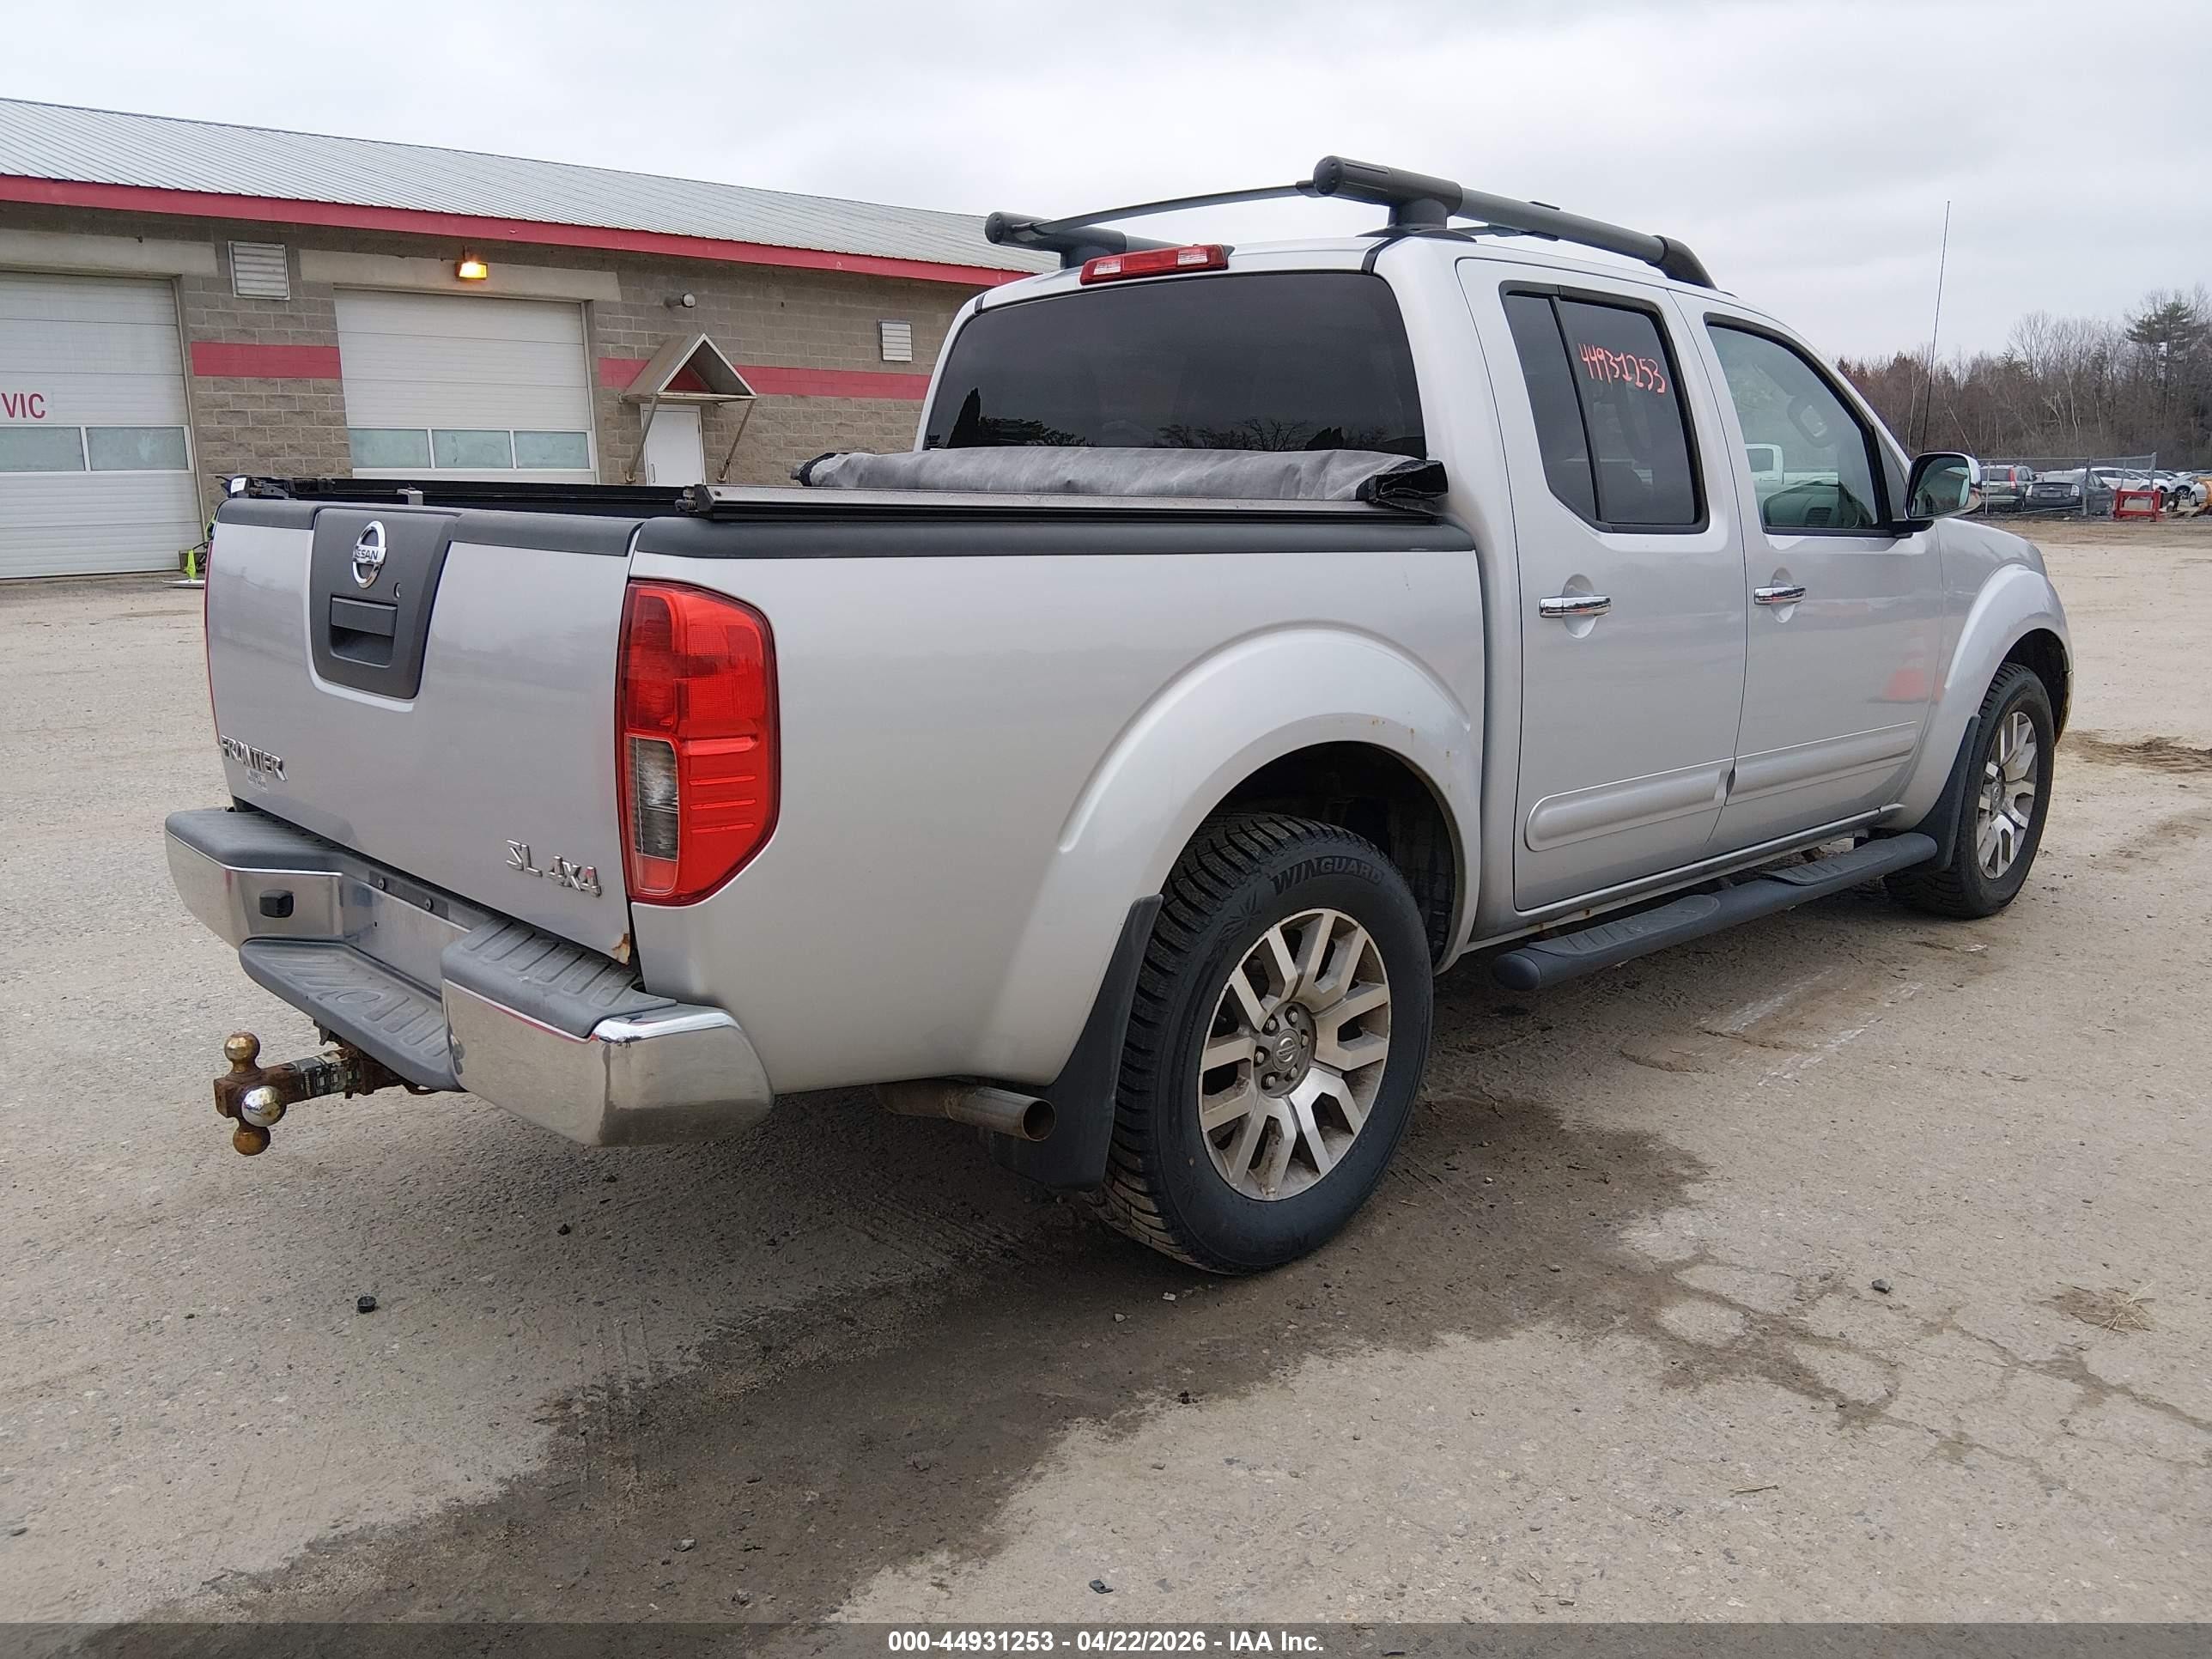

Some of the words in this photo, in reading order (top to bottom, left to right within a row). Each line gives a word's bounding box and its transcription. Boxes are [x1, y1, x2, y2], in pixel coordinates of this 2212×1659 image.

[1578, 343, 1666, 393] 44931253
[1, 392, 46, 419] VIC
[222, 734, 289, 781] FRONTIER
[505, 839, 543, 877] SL
[548, 854, 603, 897] 4X4
[1271, 855, 1385, 896] WINGUARD
